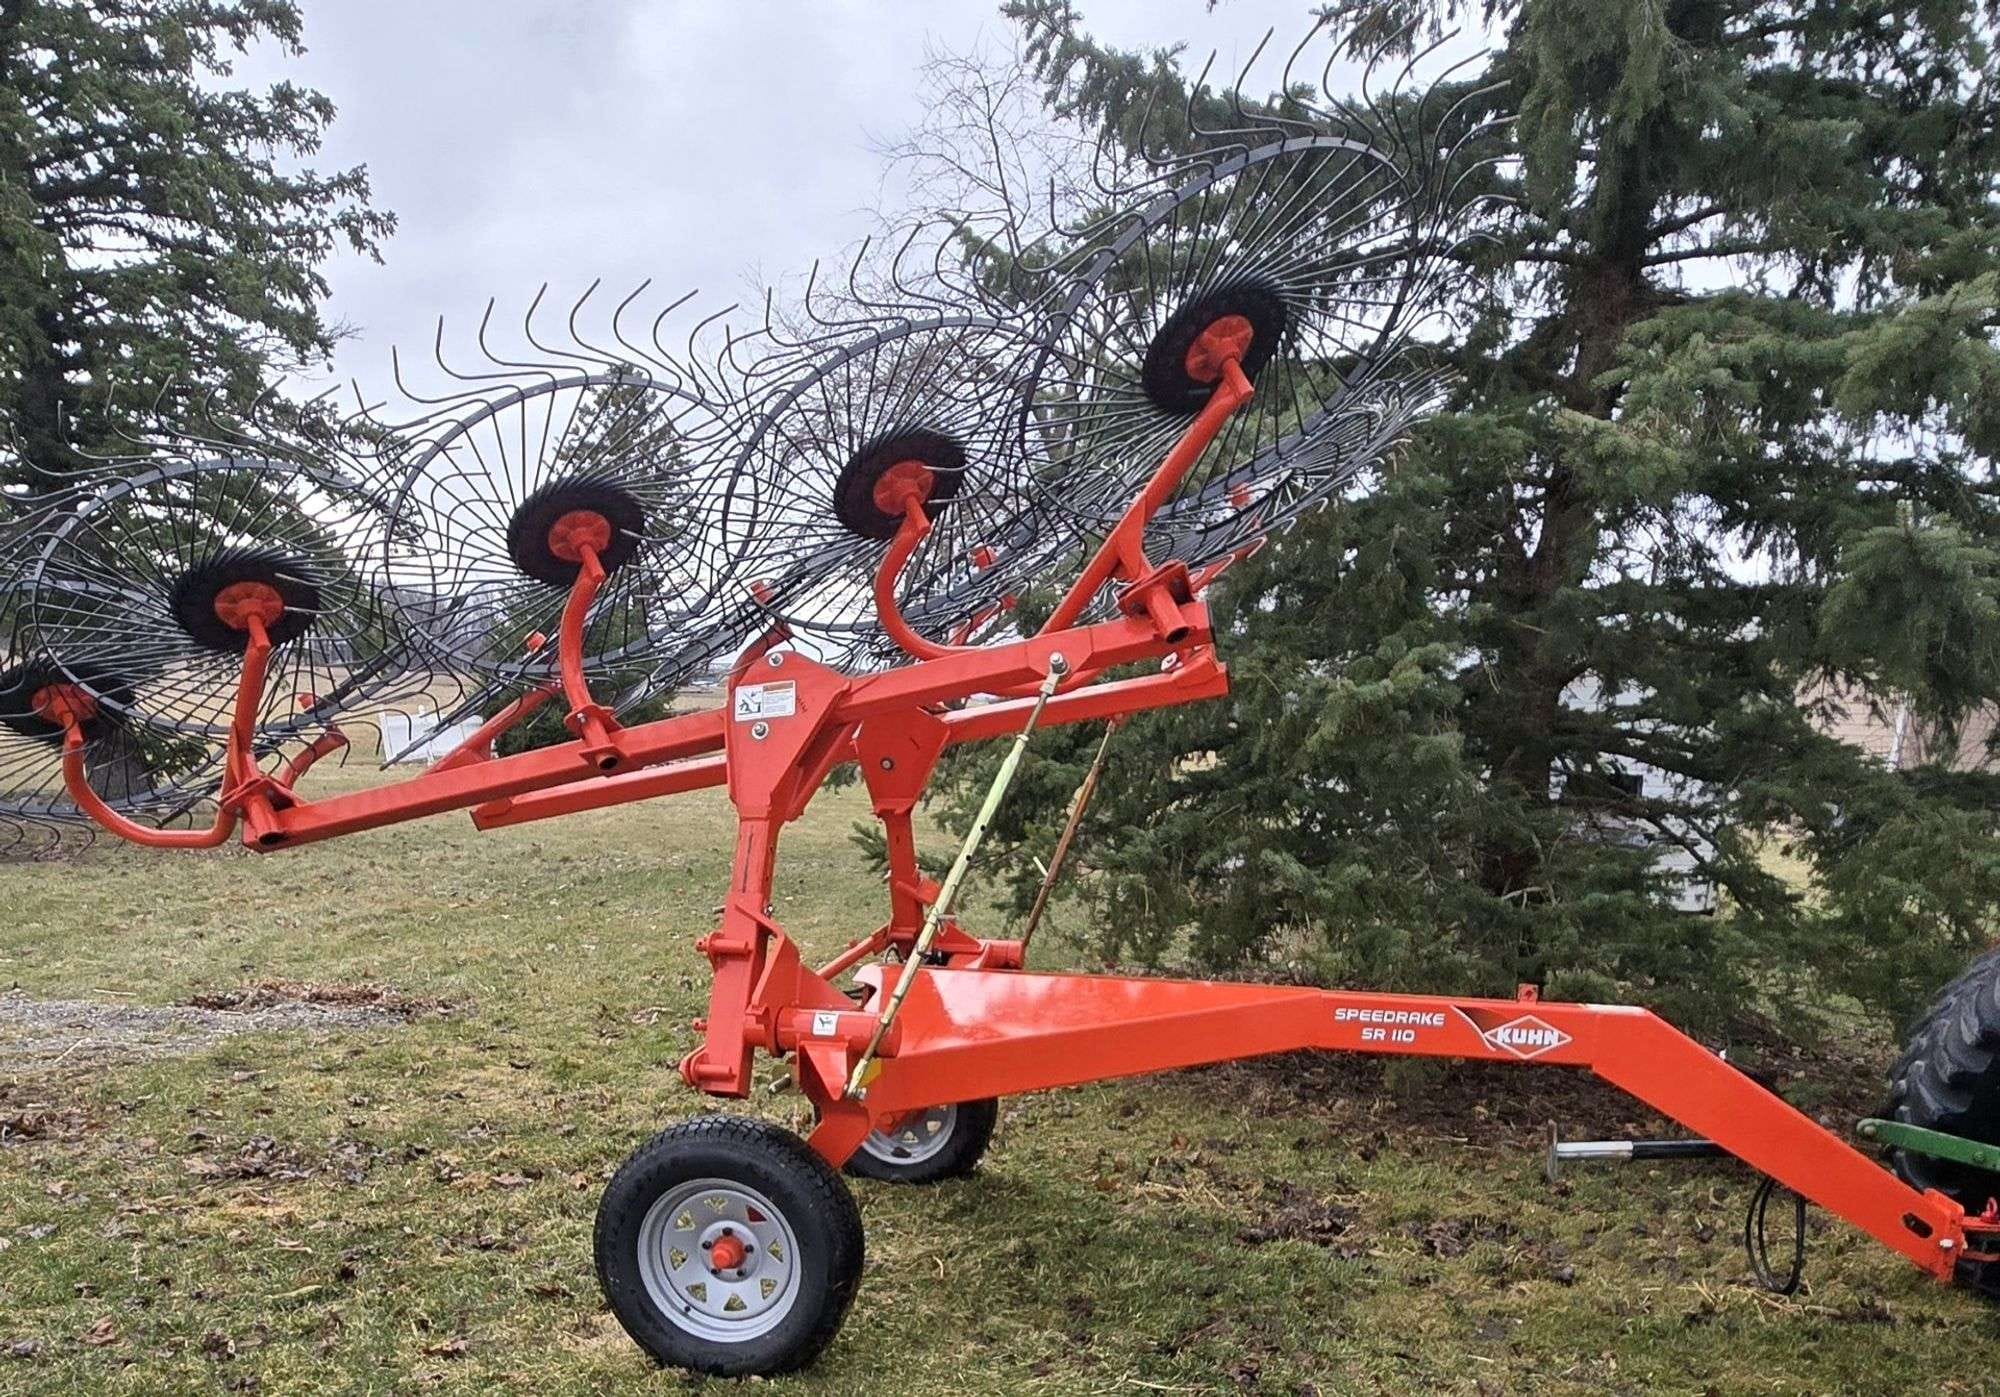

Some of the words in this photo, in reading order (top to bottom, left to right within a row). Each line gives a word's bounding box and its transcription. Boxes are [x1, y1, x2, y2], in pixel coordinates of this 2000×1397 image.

[1335, 1008, 1445, 1026] SPEEDRAKE
[1361, 1027, 1385, 1041] SR
[1391, 1029, 1415, 1042] 110
[1496, 1028, 1559, 1045] KUHN
